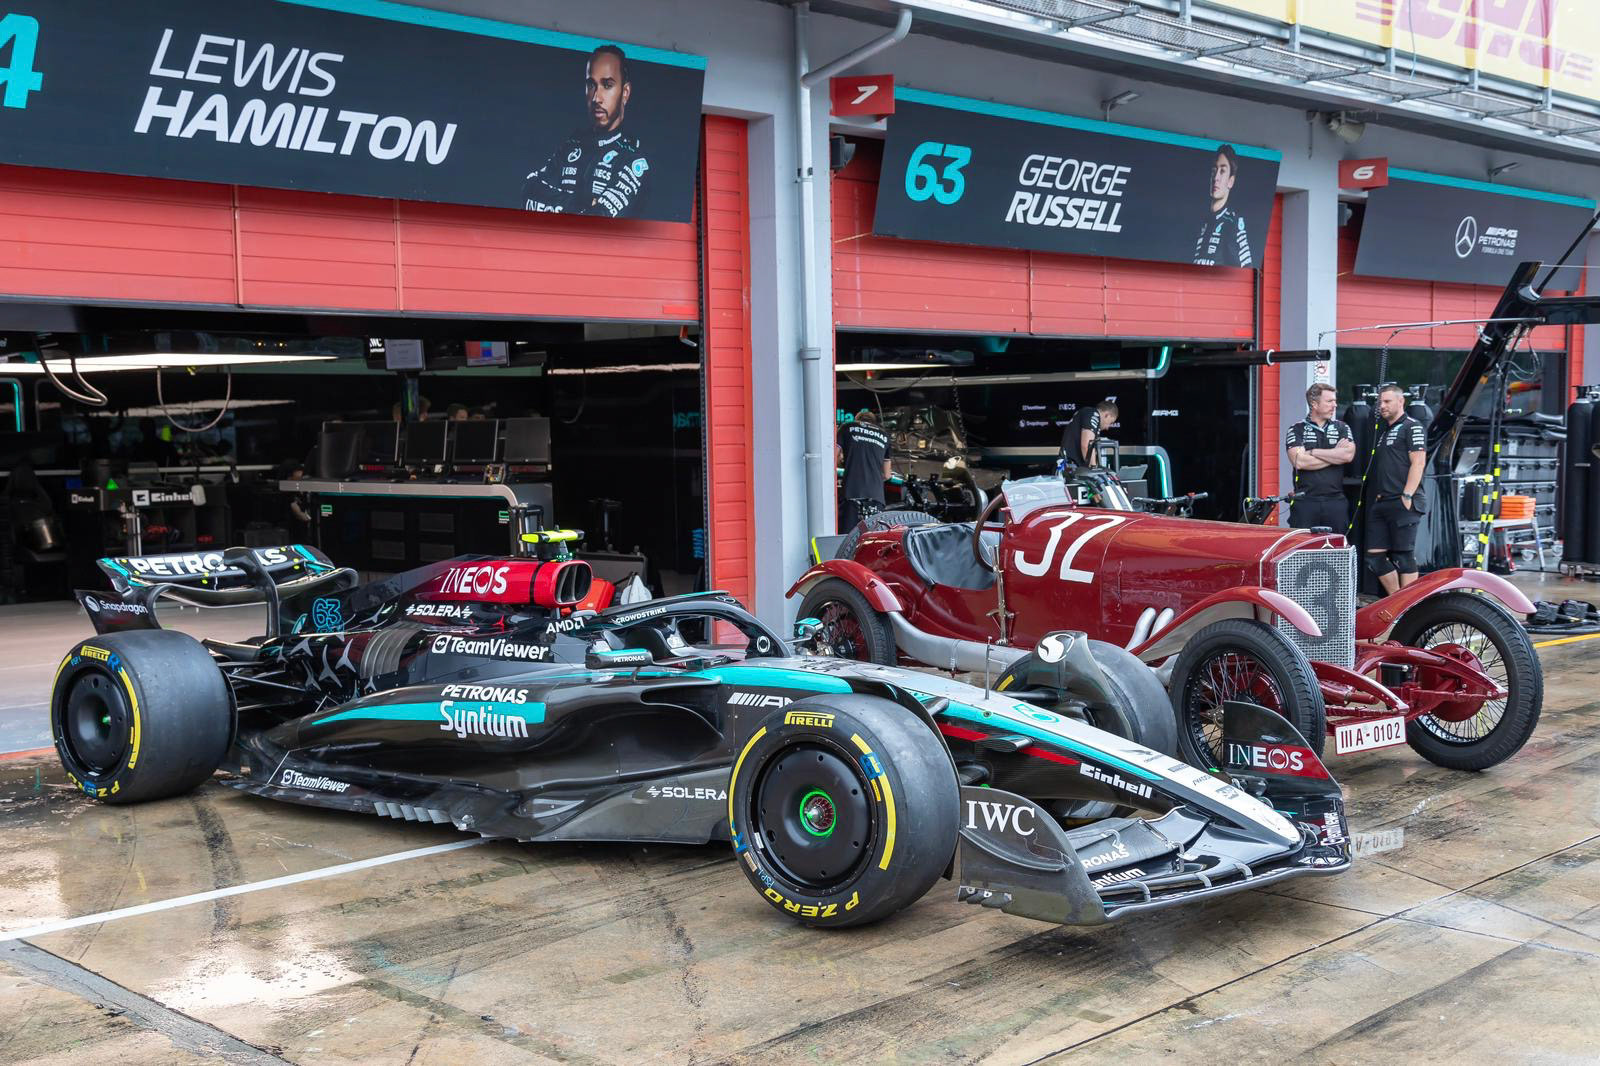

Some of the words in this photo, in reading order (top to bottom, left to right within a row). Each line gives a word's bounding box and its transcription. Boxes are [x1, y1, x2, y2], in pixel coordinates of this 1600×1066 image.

[149, 28, 344, 97] LEWIS
[851, 85, 879, 105] 7
[134, 86, 457, 165] HAMILTON
[905, 141, 972, 205] 63
[1018, 153, 1132, 197] GEORGE
[1352, 166, 1375, 180] 6
[1005, 191, 1122, 233] RUSSELL
[1478, 236, 1516, 248] PETRONAS
[1489, 226, 1518, 238] AMG
[849, 426, 888, 443] PETRONAS
[151, 491, 193, 502] Einhel
[1014, 511, 1127, 585] 32
[440, 565, 511, 594] INEOS
[99, 600, 149, 615] Snapdragon
[312, 598, 342, 627] 63
[413, 605, 463, 617] SOLERA
[614, 607, 668, 625] CROWDSTRIKE
[545, 618, 575, 635] AMD
[449, 637, 549, 660] TeamViewer
[613, 655, 646, 663] PETRONAS
[441, 684, 529, 704] PETRONAS
[440, 700, 529, 739] Syntium
[784, 711, 836, 728] PIRELLI
[1228, 742, 1304, 770] INEOS
[293, 773, 350, 793] TeamViewer
[1079, 763, 1153, 799] Einhell
[661, 786, 728, 801] SOLERA
[965, 800, 1035, 836] IWC
[763, 887, 838, 918] ZERO
